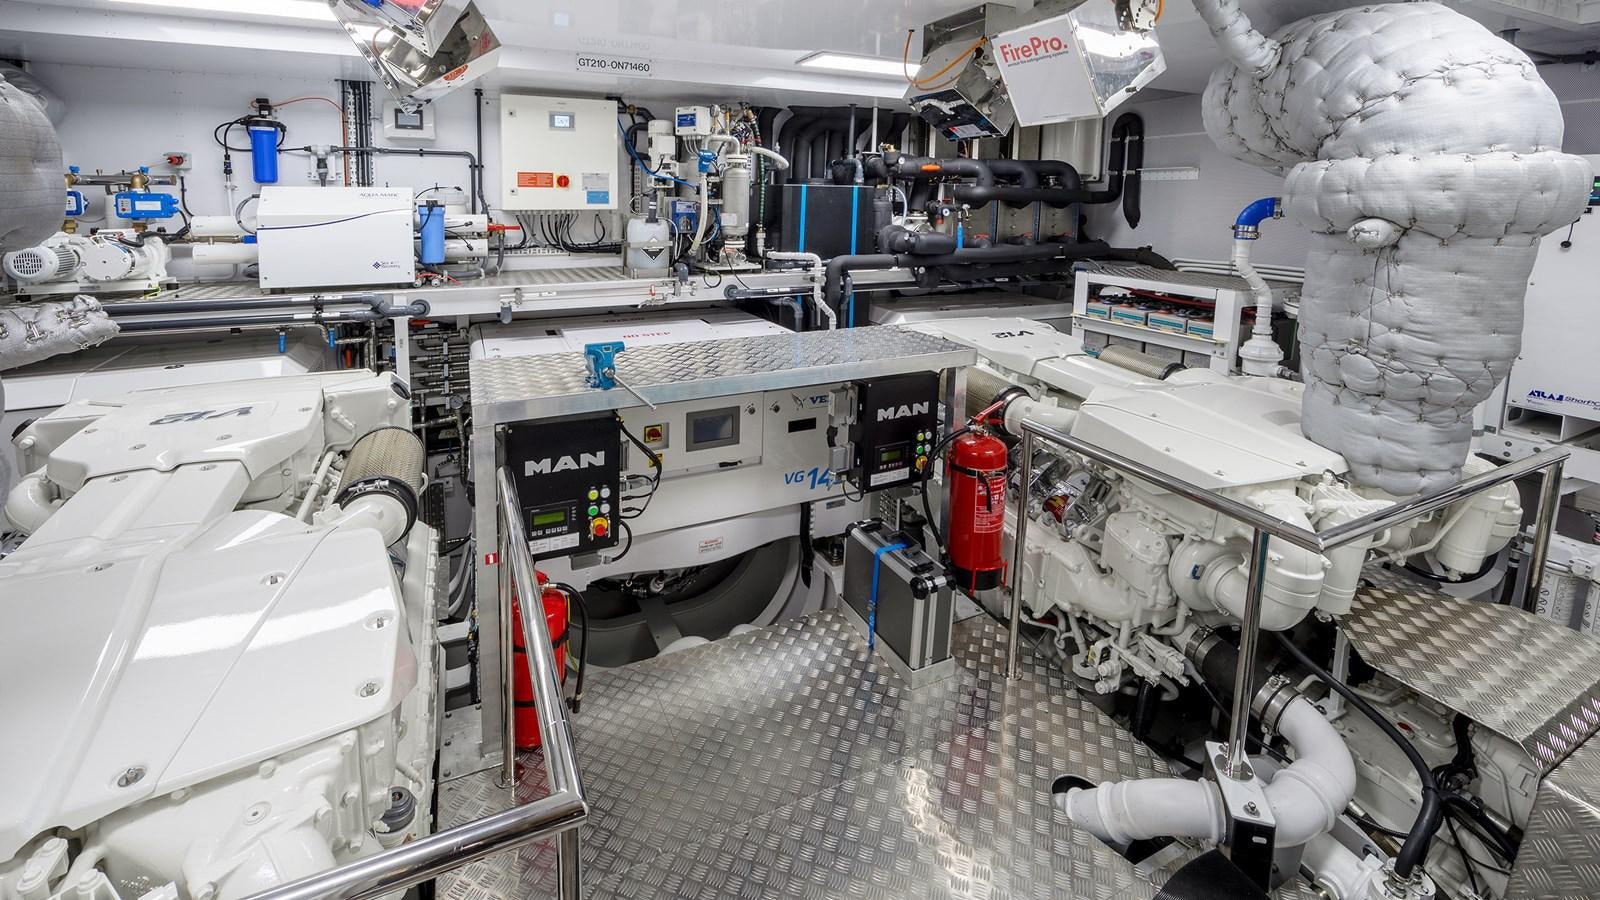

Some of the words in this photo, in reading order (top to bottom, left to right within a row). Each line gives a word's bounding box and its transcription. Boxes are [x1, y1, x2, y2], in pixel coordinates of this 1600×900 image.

[149, 406, 253, 426] V12
[877, 401, 929, 422] MAN
[524, 450, 605, 477] MAN
